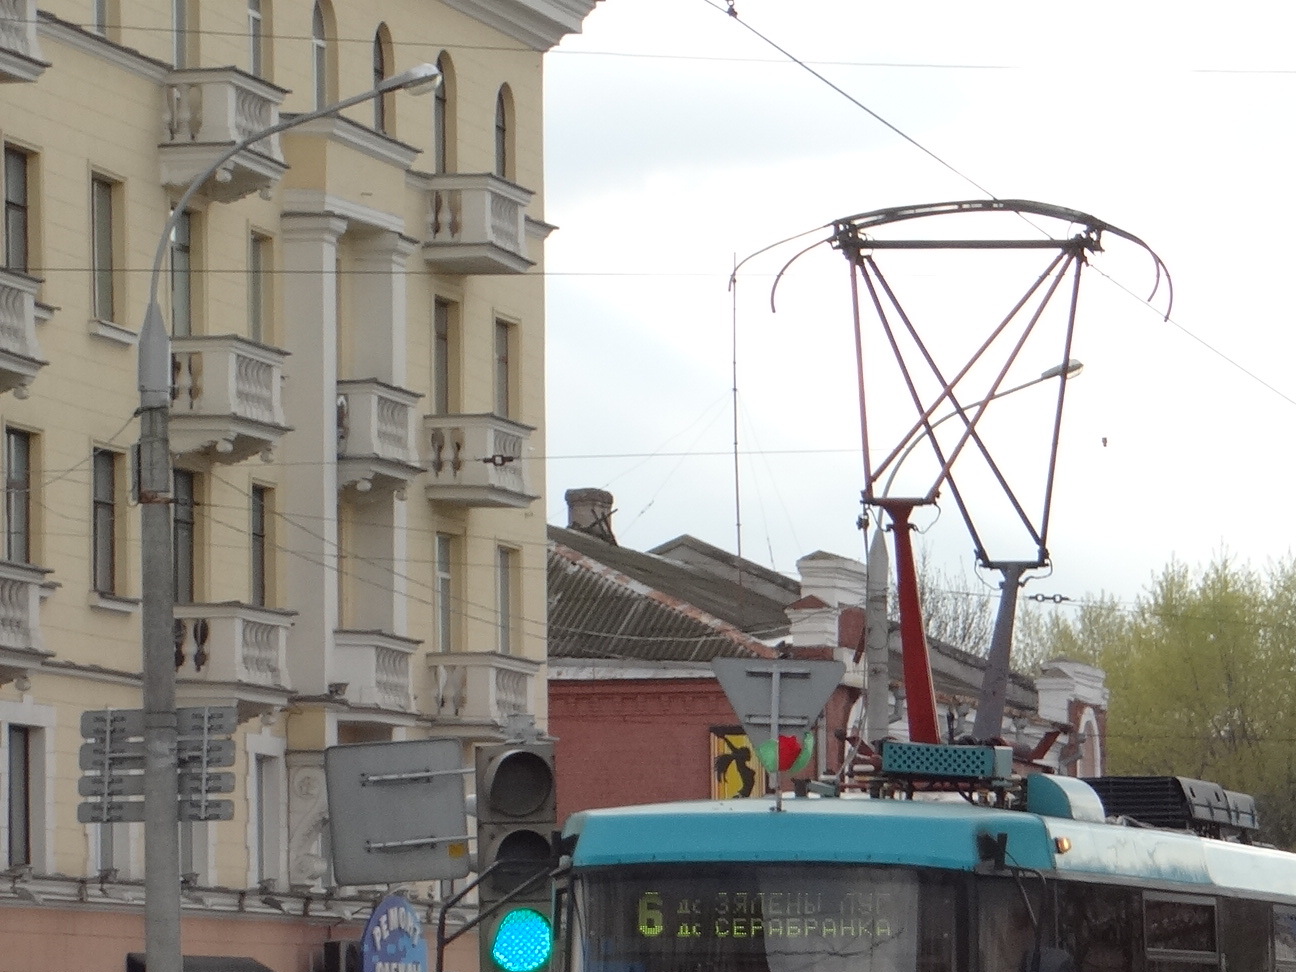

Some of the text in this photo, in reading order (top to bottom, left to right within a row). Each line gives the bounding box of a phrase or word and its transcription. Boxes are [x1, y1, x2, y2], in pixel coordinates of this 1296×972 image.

[372, 906, 421, 951] РЕМОНТ
[638, 892, 664, 937] 6
[714, 917, 893, 938] СЕРАБРАНКА
